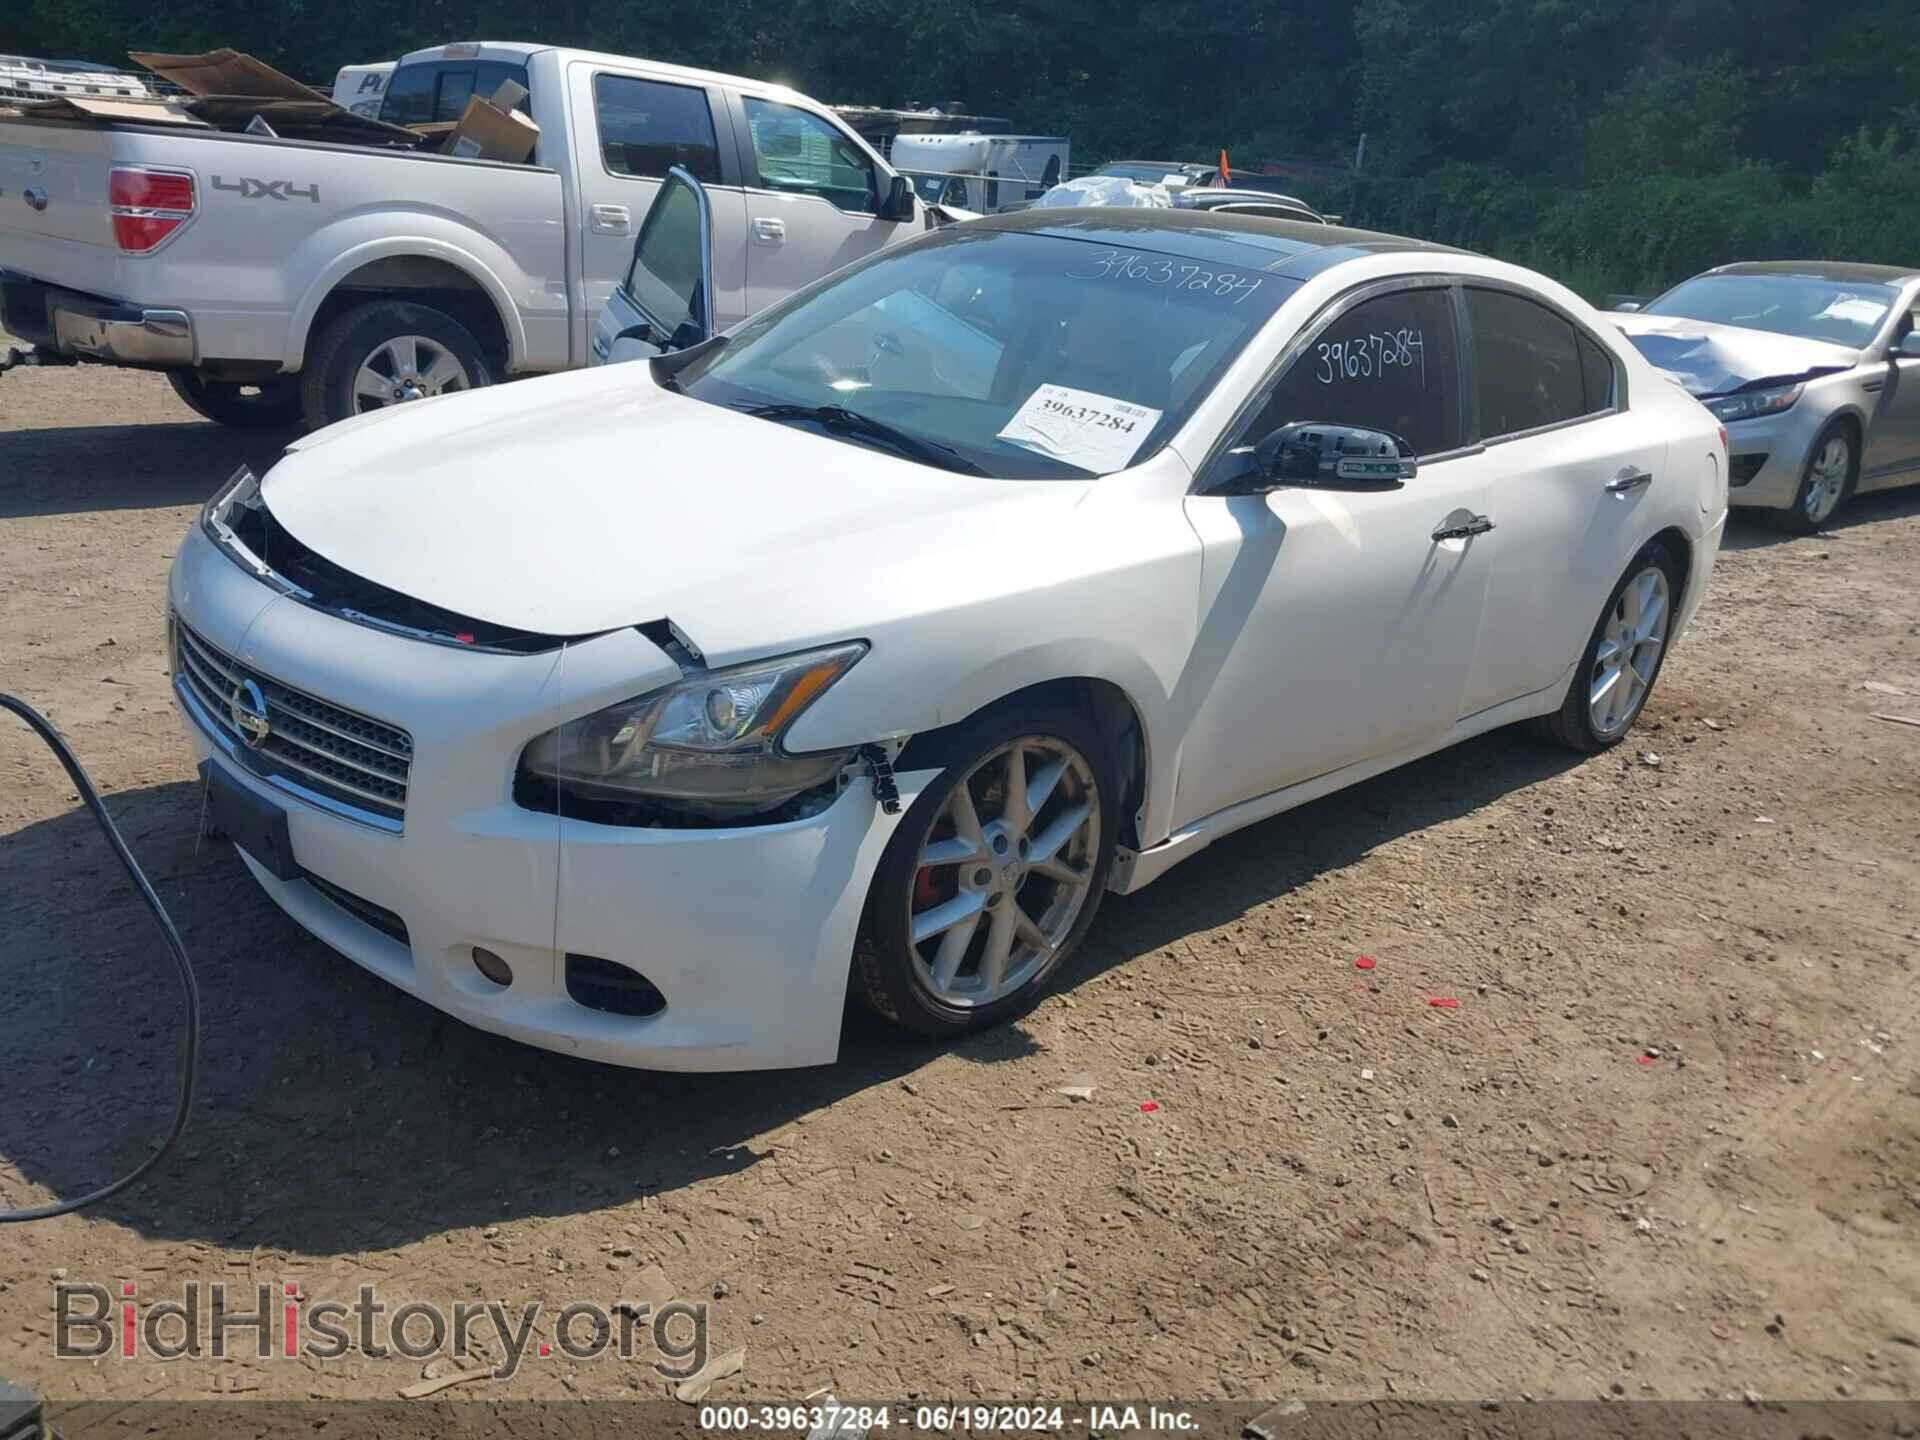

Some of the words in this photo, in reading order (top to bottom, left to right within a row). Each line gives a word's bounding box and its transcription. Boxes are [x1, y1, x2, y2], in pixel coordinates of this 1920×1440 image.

[1065, 250, 1263, 304] 39637284
[1317, 328, 1425, 388] 39637284
[1037, 399, 1136, 433] 39637284
